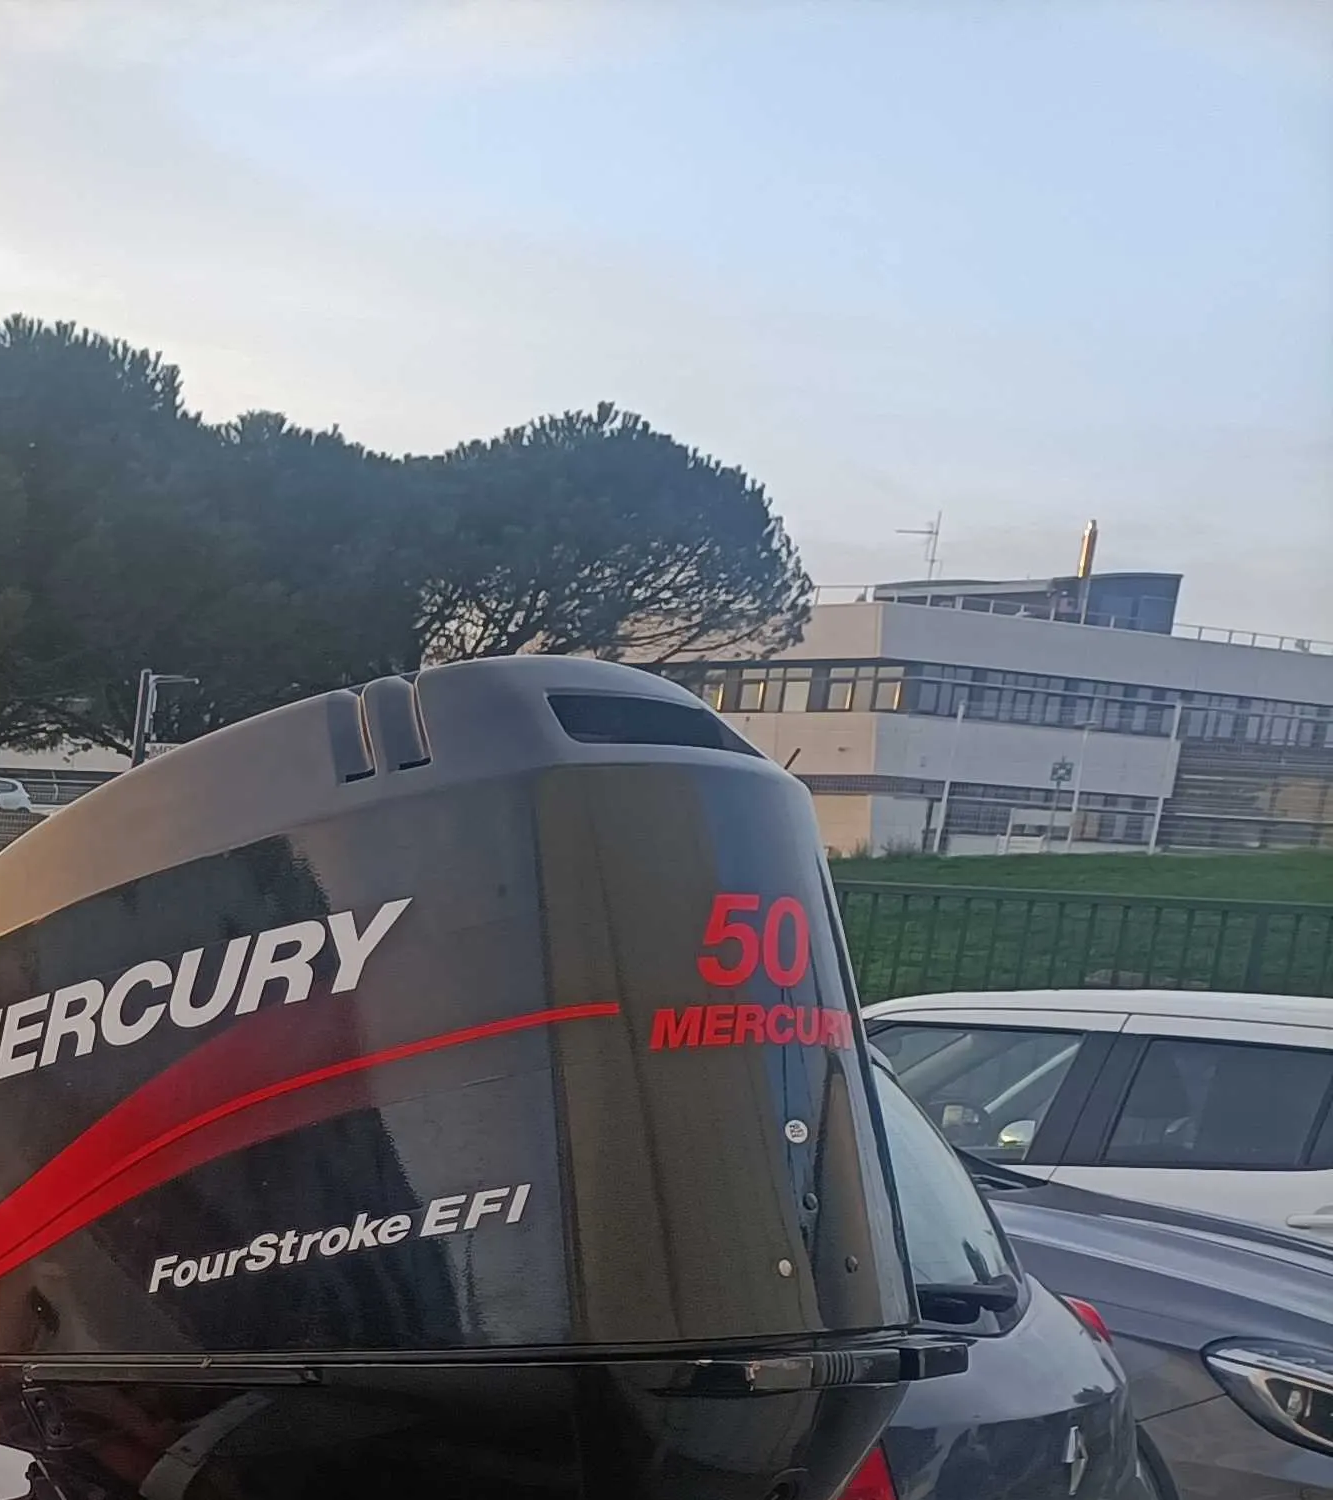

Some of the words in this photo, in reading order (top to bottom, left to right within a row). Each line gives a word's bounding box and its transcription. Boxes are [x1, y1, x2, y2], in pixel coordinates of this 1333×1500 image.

[696, 893, 810, 988] 50
[148, 1212, 414, 1294] FourStroke
[419, 1183, 531, 1240] EFI
